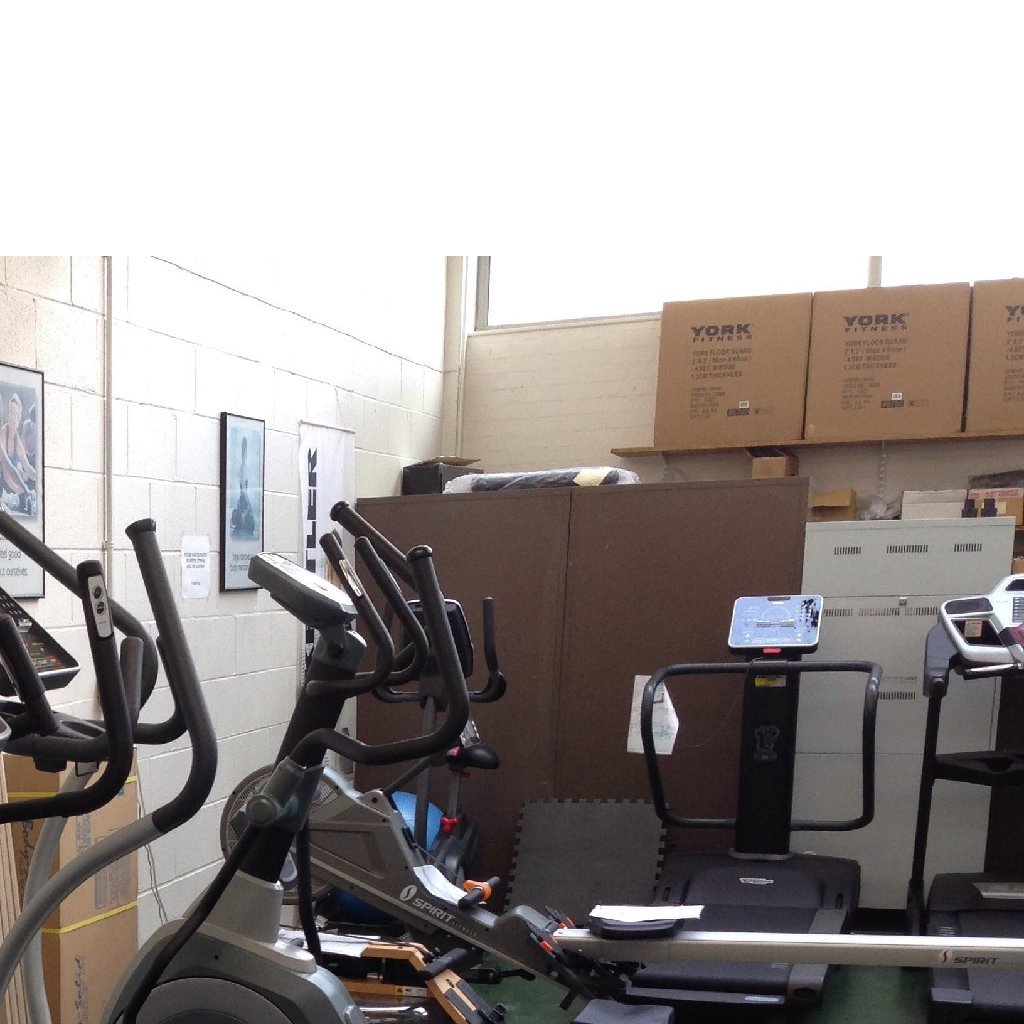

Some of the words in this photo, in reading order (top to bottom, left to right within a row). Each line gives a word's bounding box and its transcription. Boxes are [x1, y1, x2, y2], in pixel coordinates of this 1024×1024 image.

[843, 313, 906, 326] YORK
[691, 324, 751, 336] YORK
[845, 325, 908, 333] FITNESS
[692, 334, 753, 343] FITNESS
[412, 898, 456, 923] SPIRIT
[954, 956, 1000, 965] SPIRIT
